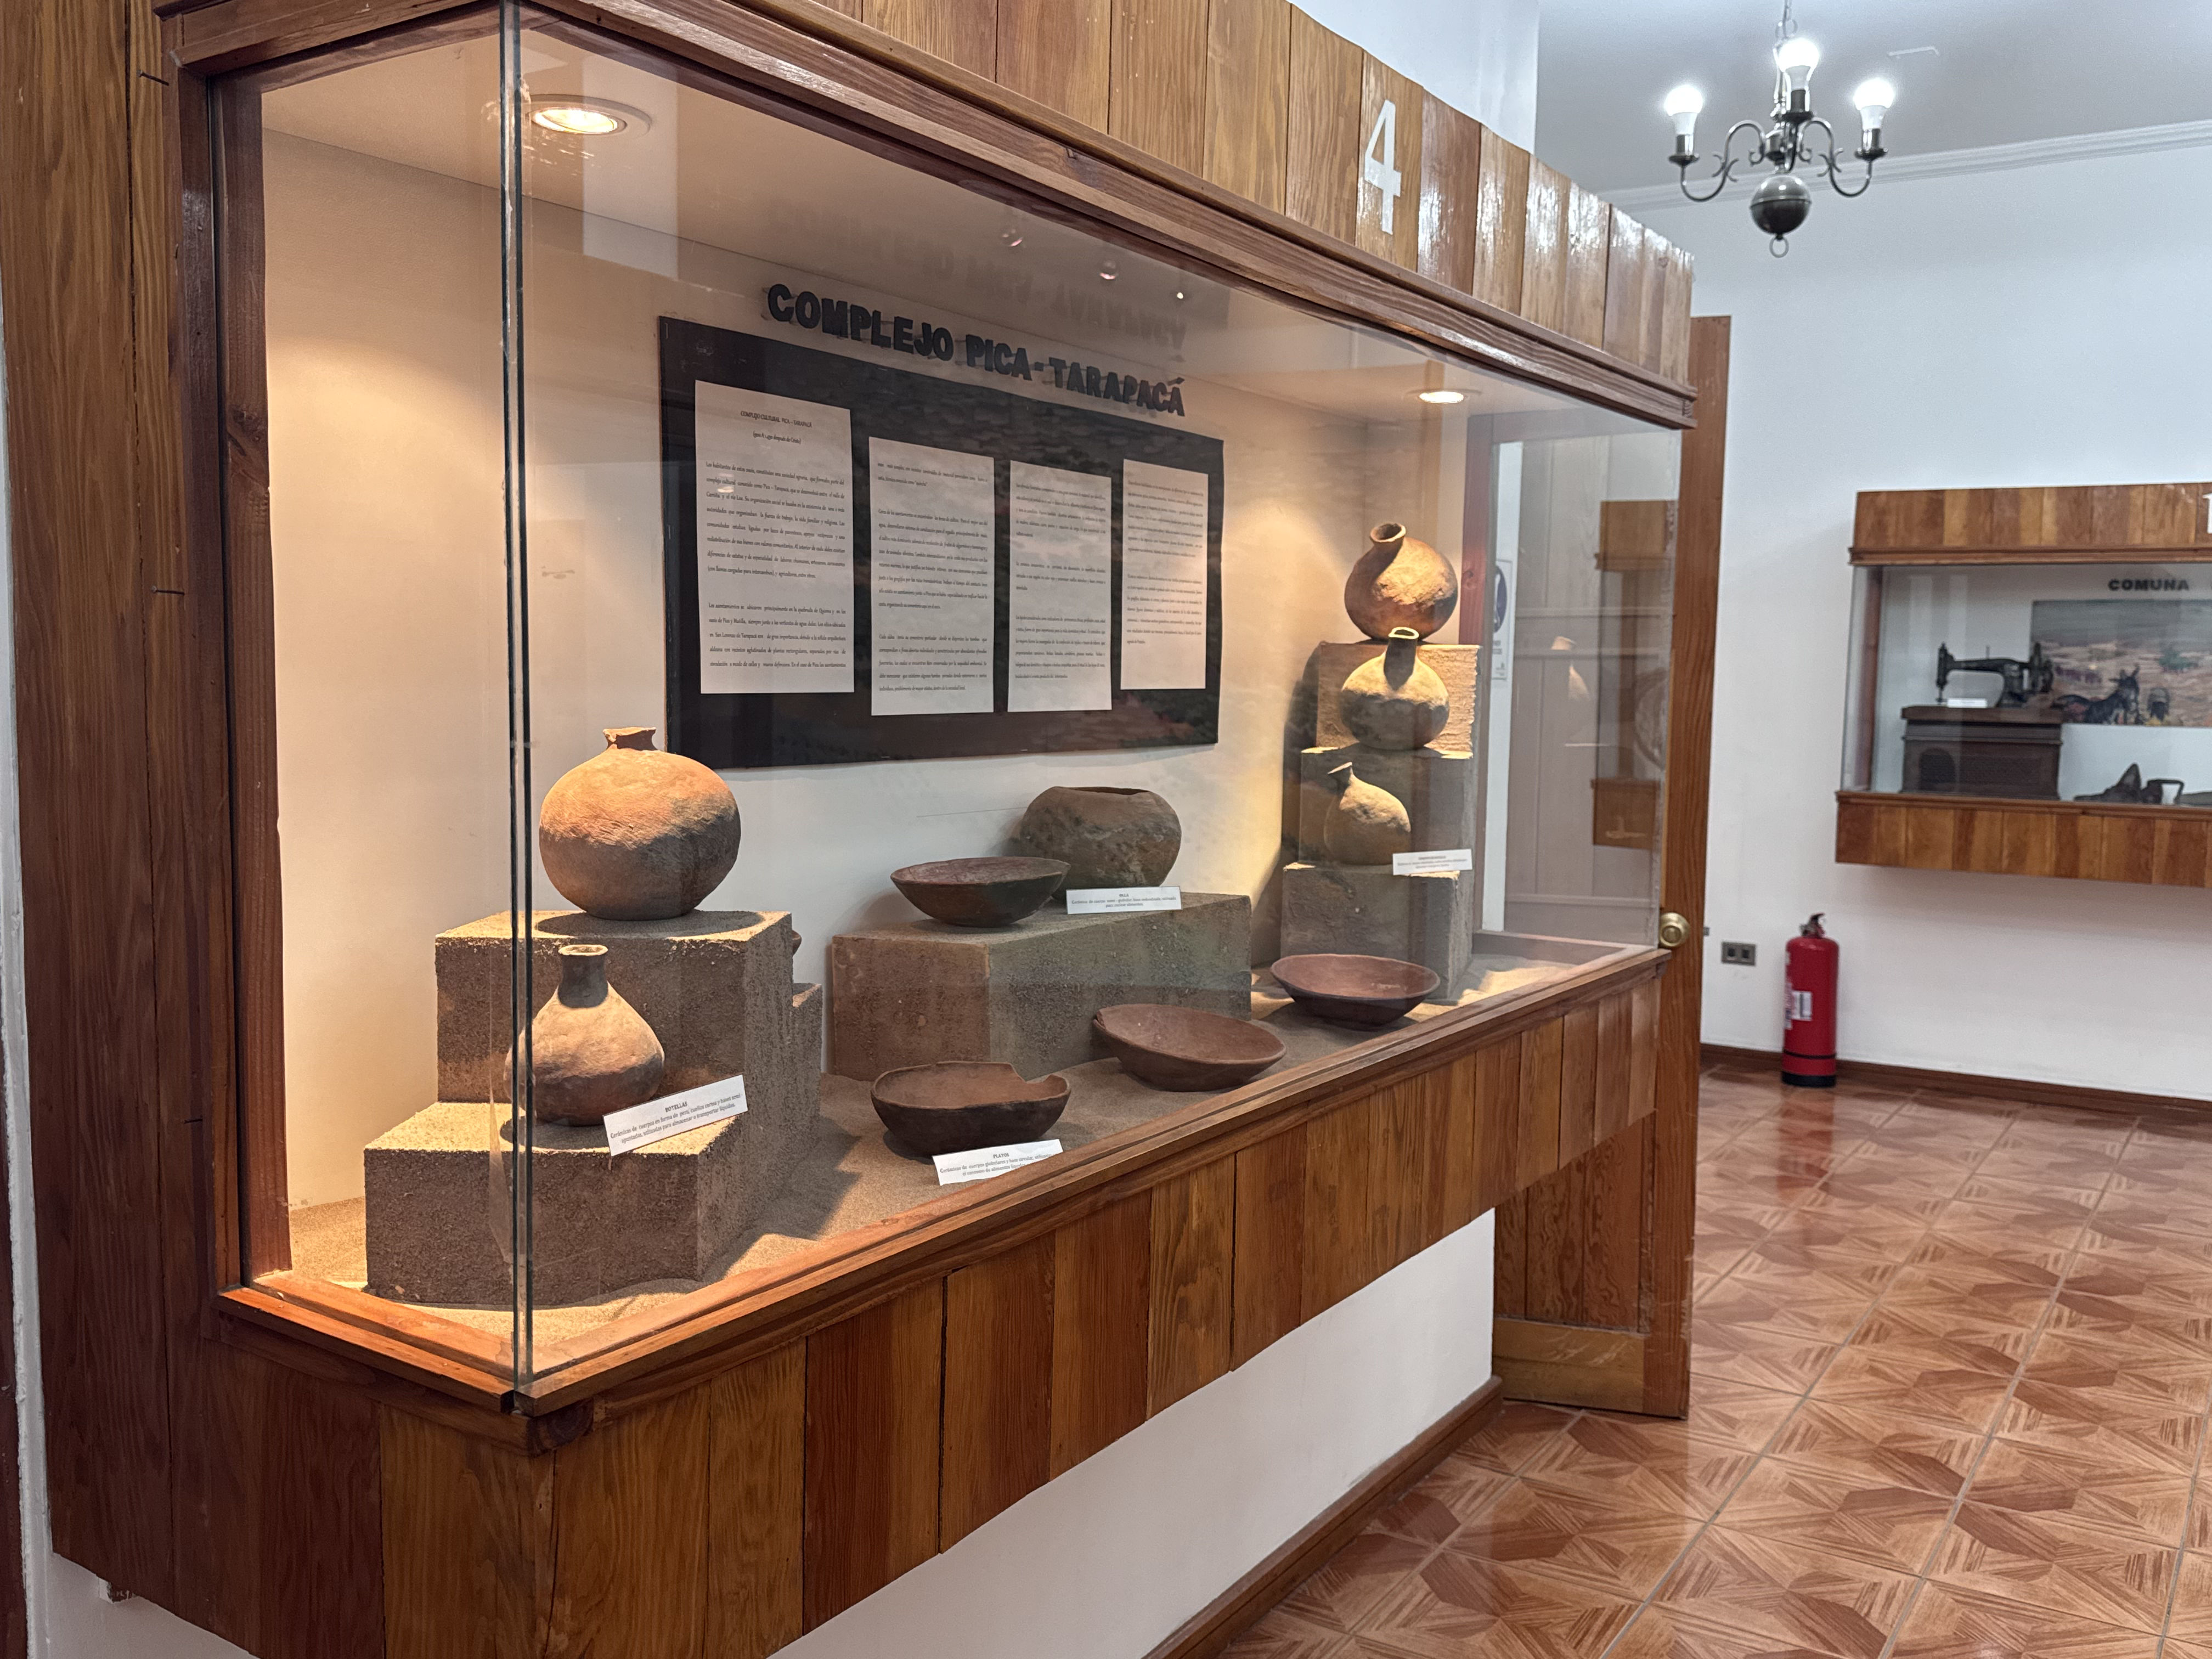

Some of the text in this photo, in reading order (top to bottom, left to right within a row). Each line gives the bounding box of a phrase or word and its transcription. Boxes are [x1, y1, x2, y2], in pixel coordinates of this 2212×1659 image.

[1364, 99, 1401, 235] 4
[768, 284, 953, 361] COMPLEJO
[2108, 579, 2189, 591] COMUNA
[665, 1101, 687, 1113] BOTELLAS
